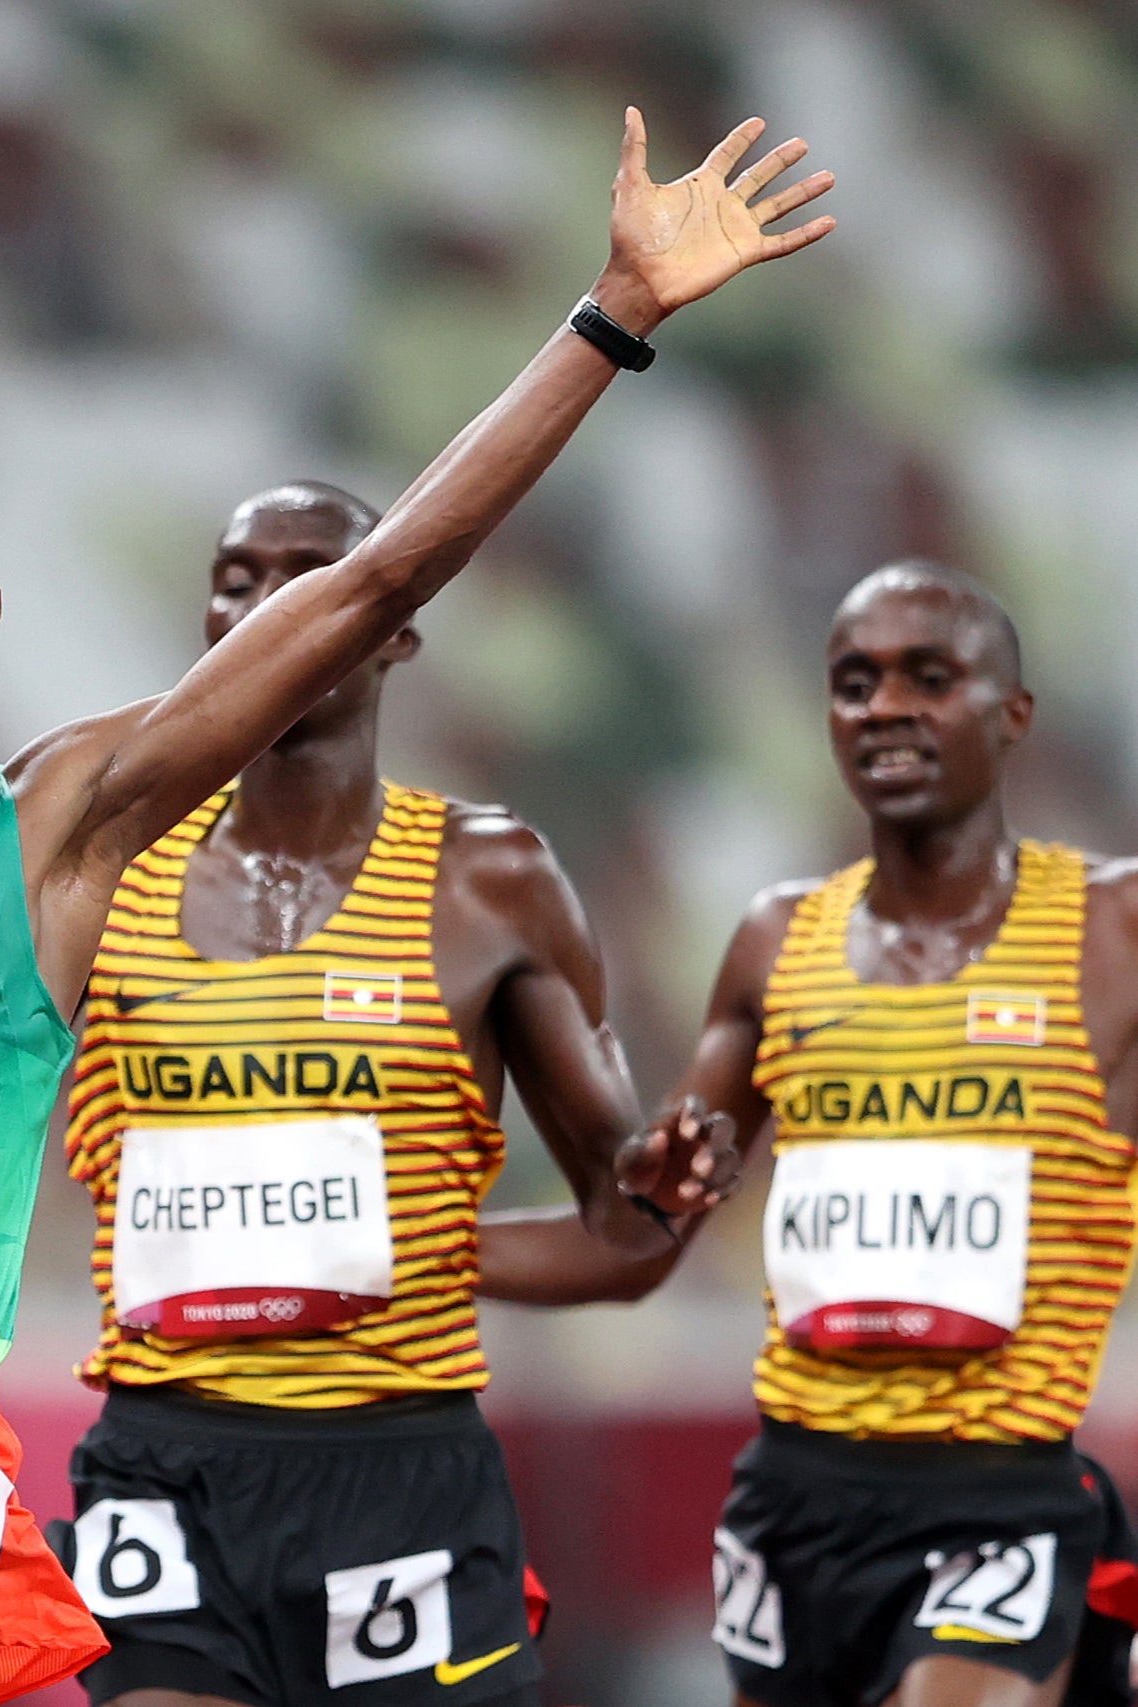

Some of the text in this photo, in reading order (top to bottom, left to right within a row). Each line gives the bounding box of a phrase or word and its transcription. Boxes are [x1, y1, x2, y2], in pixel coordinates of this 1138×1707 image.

[123, 1052, 382, 1100] UGANDA
[130, 1175, 361, 1231] CHEPTEGEI
[781, 1193, 1001, 1250] KIPLIMO
[99, 1513, 162, 1598] 6
[355, 1578, 417, 1660] 6
